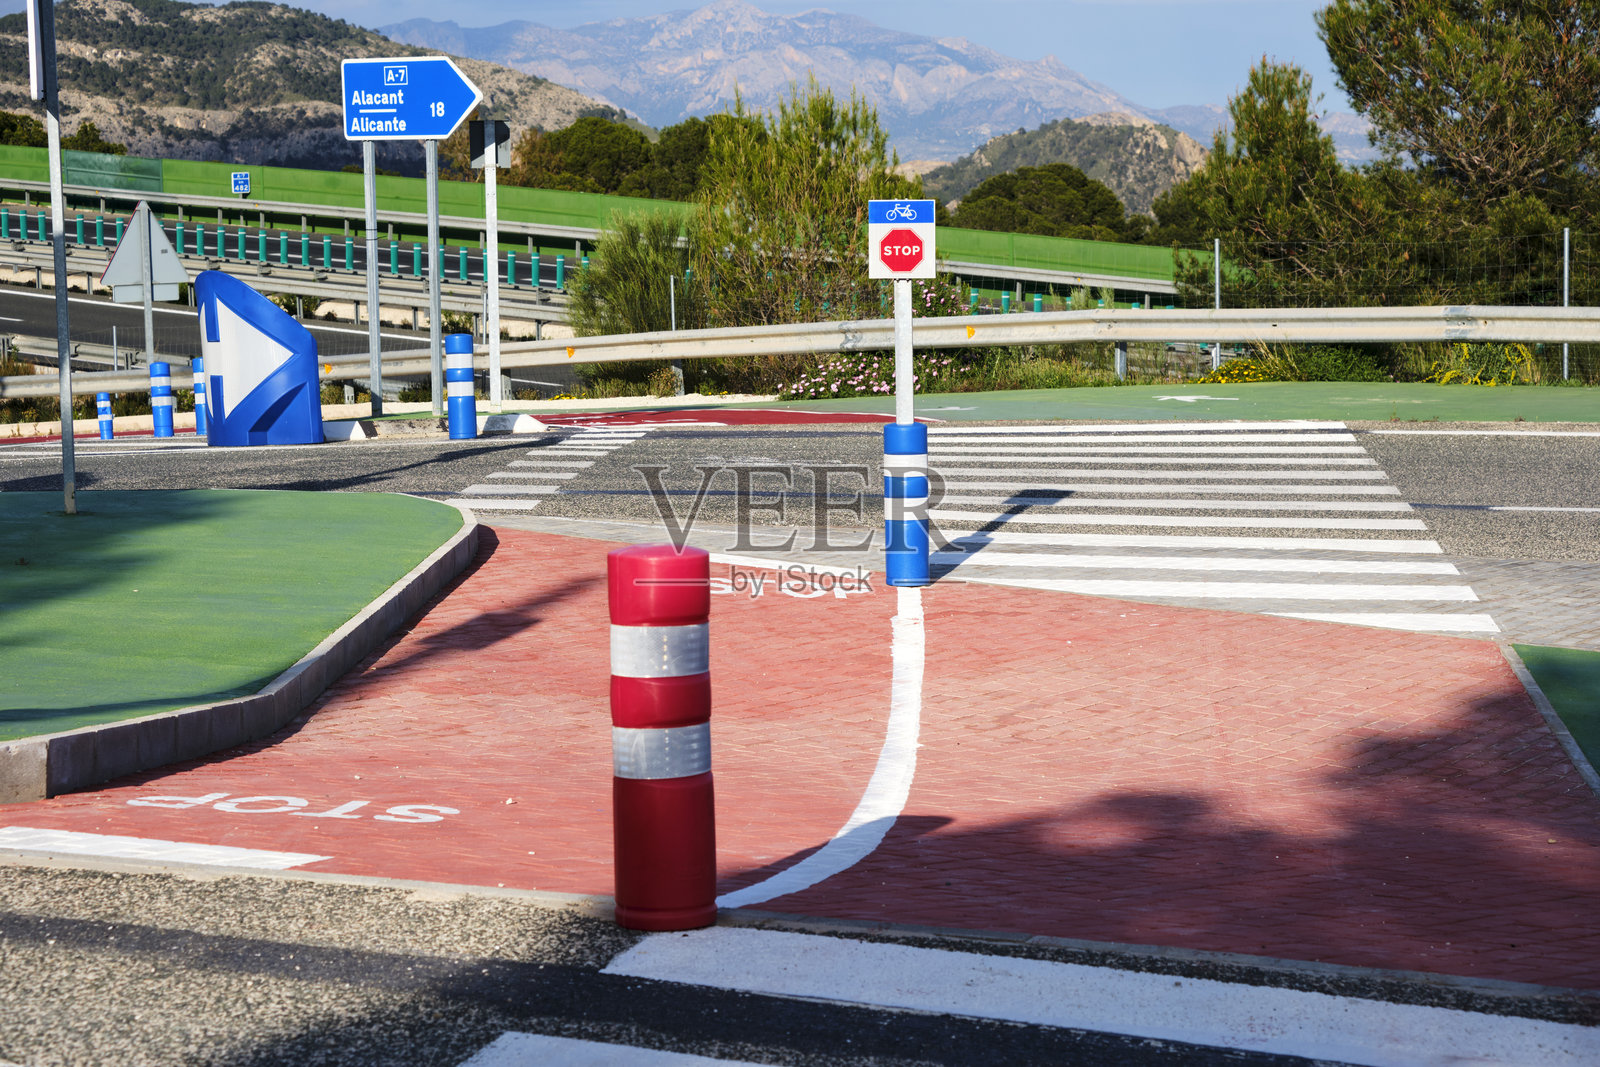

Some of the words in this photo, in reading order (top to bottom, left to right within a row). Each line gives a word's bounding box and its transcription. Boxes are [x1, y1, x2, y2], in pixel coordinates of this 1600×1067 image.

[387, 69, 406, 82] A-7
[352, 89, 404, 105] Alacant
[430, 102, 445, 117] 18
[351, 117, 406, 132] Alicante
[883, 245, 920, 256] STOP
[126, 792, 461, 823] STOP
